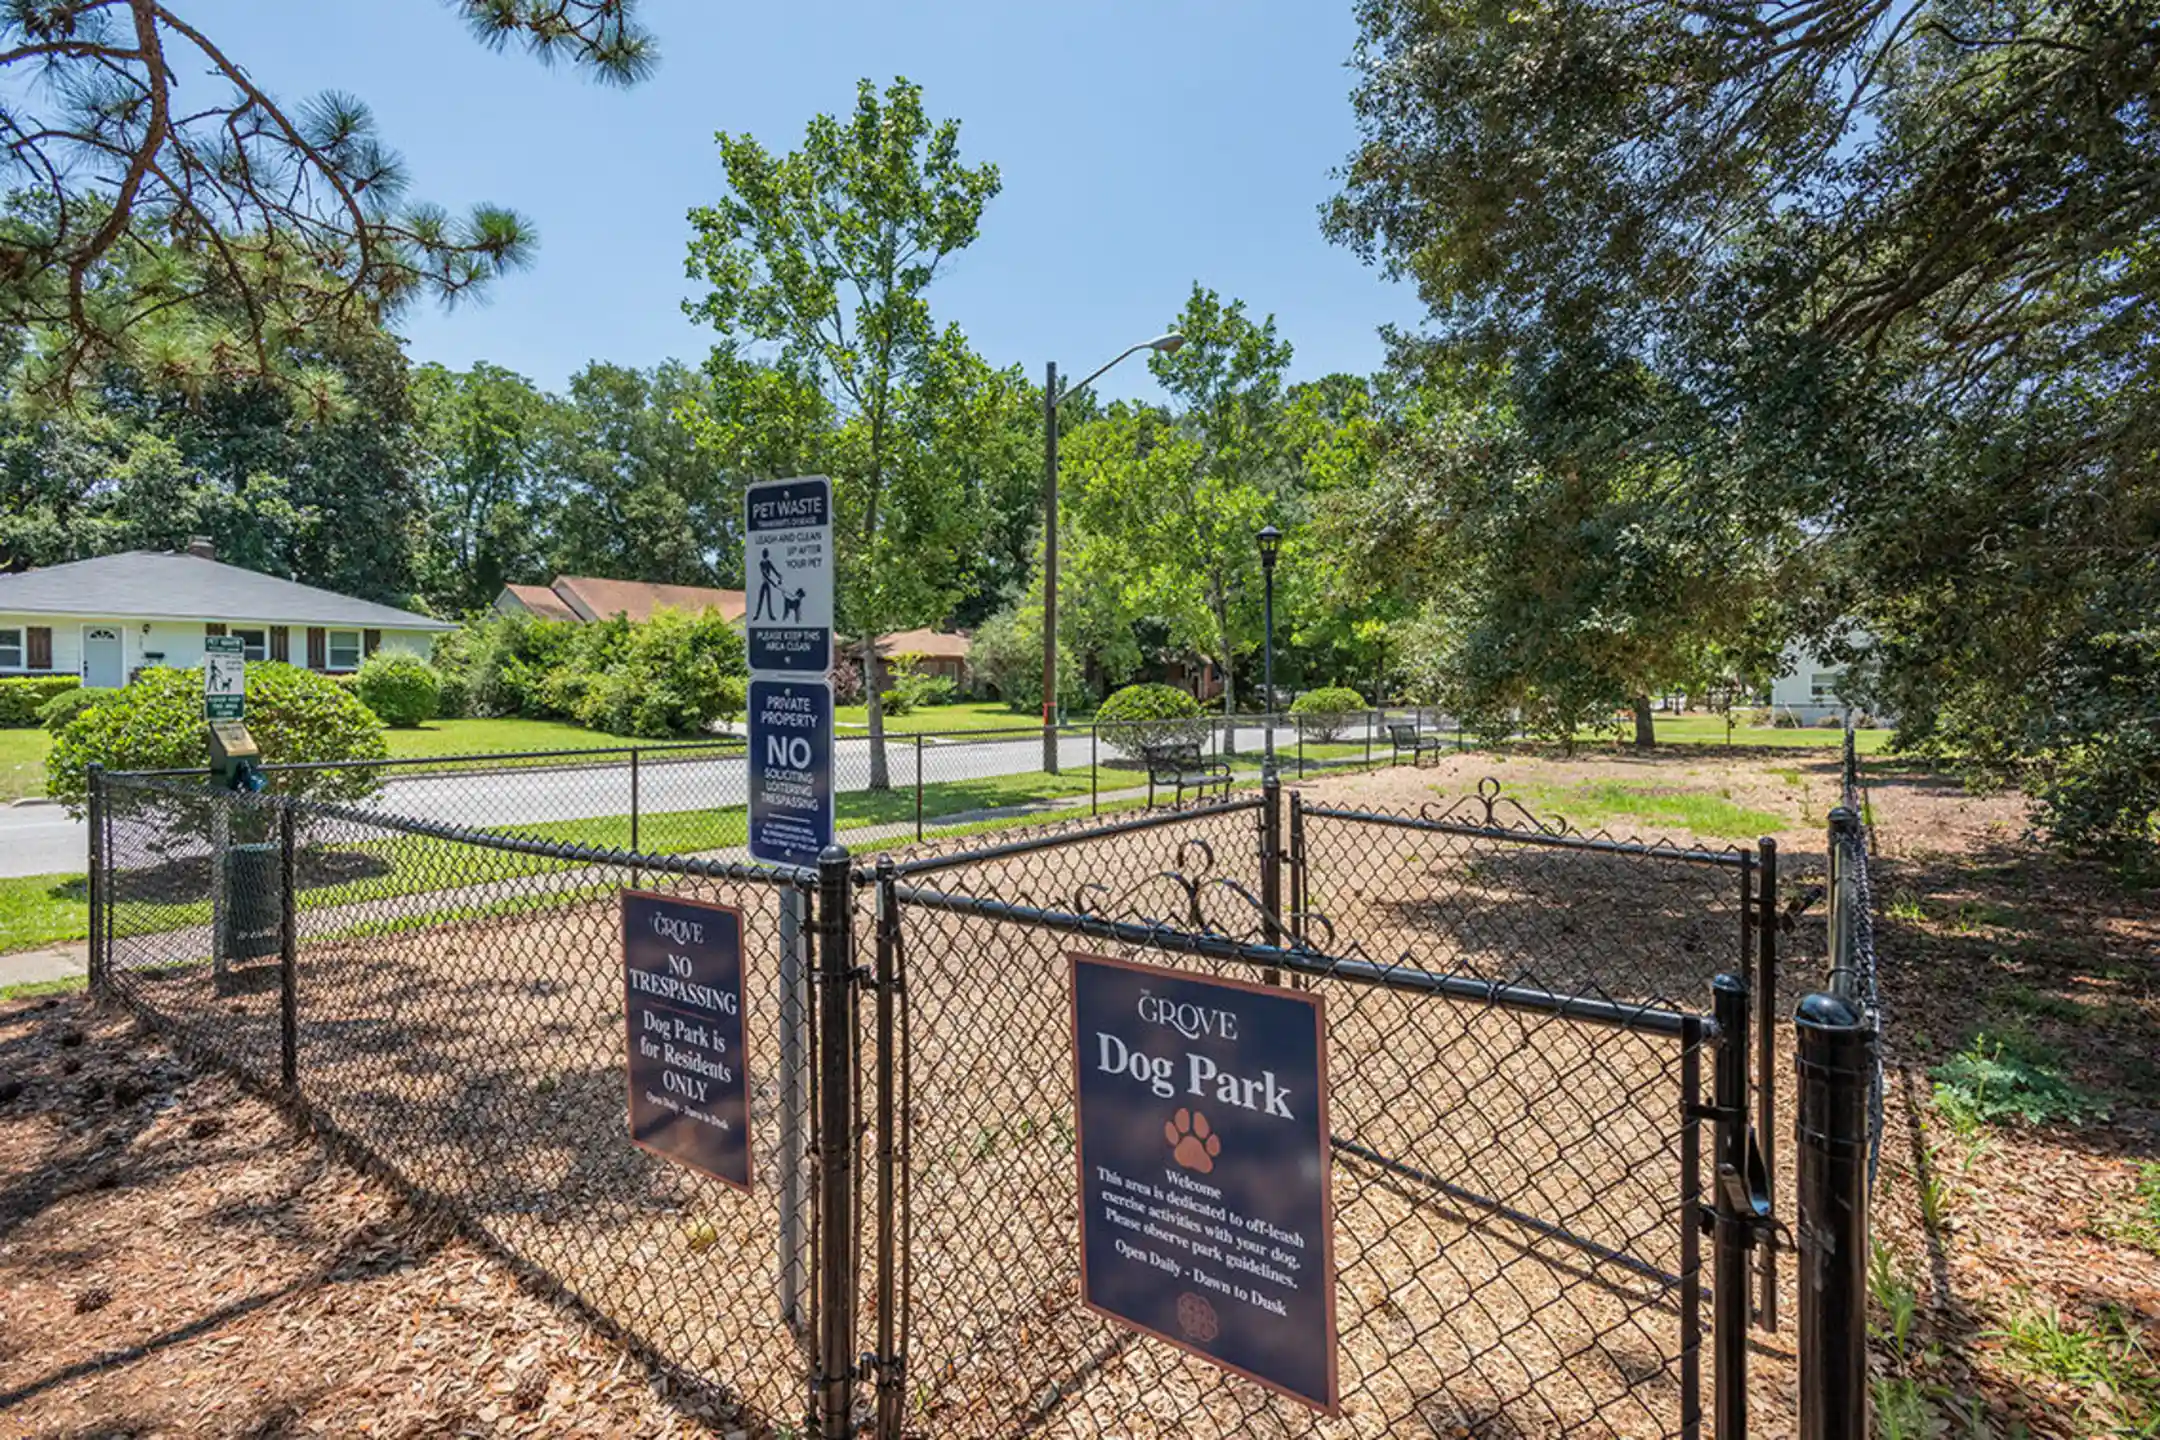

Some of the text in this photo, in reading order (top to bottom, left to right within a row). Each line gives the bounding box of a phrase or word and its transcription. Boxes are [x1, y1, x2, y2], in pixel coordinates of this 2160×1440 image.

[753, 497, 822, 519] PET WASTE
[779, 532, 795, 543] AND
[797, 531, 822, 542] CLEAN
[799, 543, 822, 554] AFTER
[785, 556, 823, 569] YOUR PET
[756, 630, 782, 641] PLEASE
[803, 630, 820, 641] THIS
[765, 641, 811, 652] AREA CLEAN
[761, 710, 818, 728] PROPERTY
[766, 696, 812, 712] PRIVATE
[767, 735, 812, 769] NO
[763, 767, 814, 785] SOLICITING
[764, 780, 813, 797] LOITERING
[761, 792, 819, 811] TRESPASSING
[653, 914, 704, 945] GROVE
[668, 953, 693, 978] NO
[629, 968, 738, 1015] TRESPASSING
[644, 1010, 726, 1052] Dog Park is
[1137, 995, 1238, 1040] GROVE
[640, 1035, 732, 1083] for Residents
[662, 1070, 708, 1103] ONLY
[1096, 1032, 1296, 1121] Dog Park
[1165, 1169, 1222, 1200] Welcome
[1097, 1166, 1305, 1248] This area is dedicated to off-leash
[1101, 1191, 1301, 1270] exercise activities with your dog.
[1105, 1206, 1299, 1290] Please observe park guidelines.
[1115, 1238, 1147, 1262] Open
[1149, 1250, 1181, 1278] Daily
[1193, 1268, 1231, 1294] Dawn
[1233, 1285, 1248, 1301] to
[1251, 1289, 1287, 1317] Dusk
